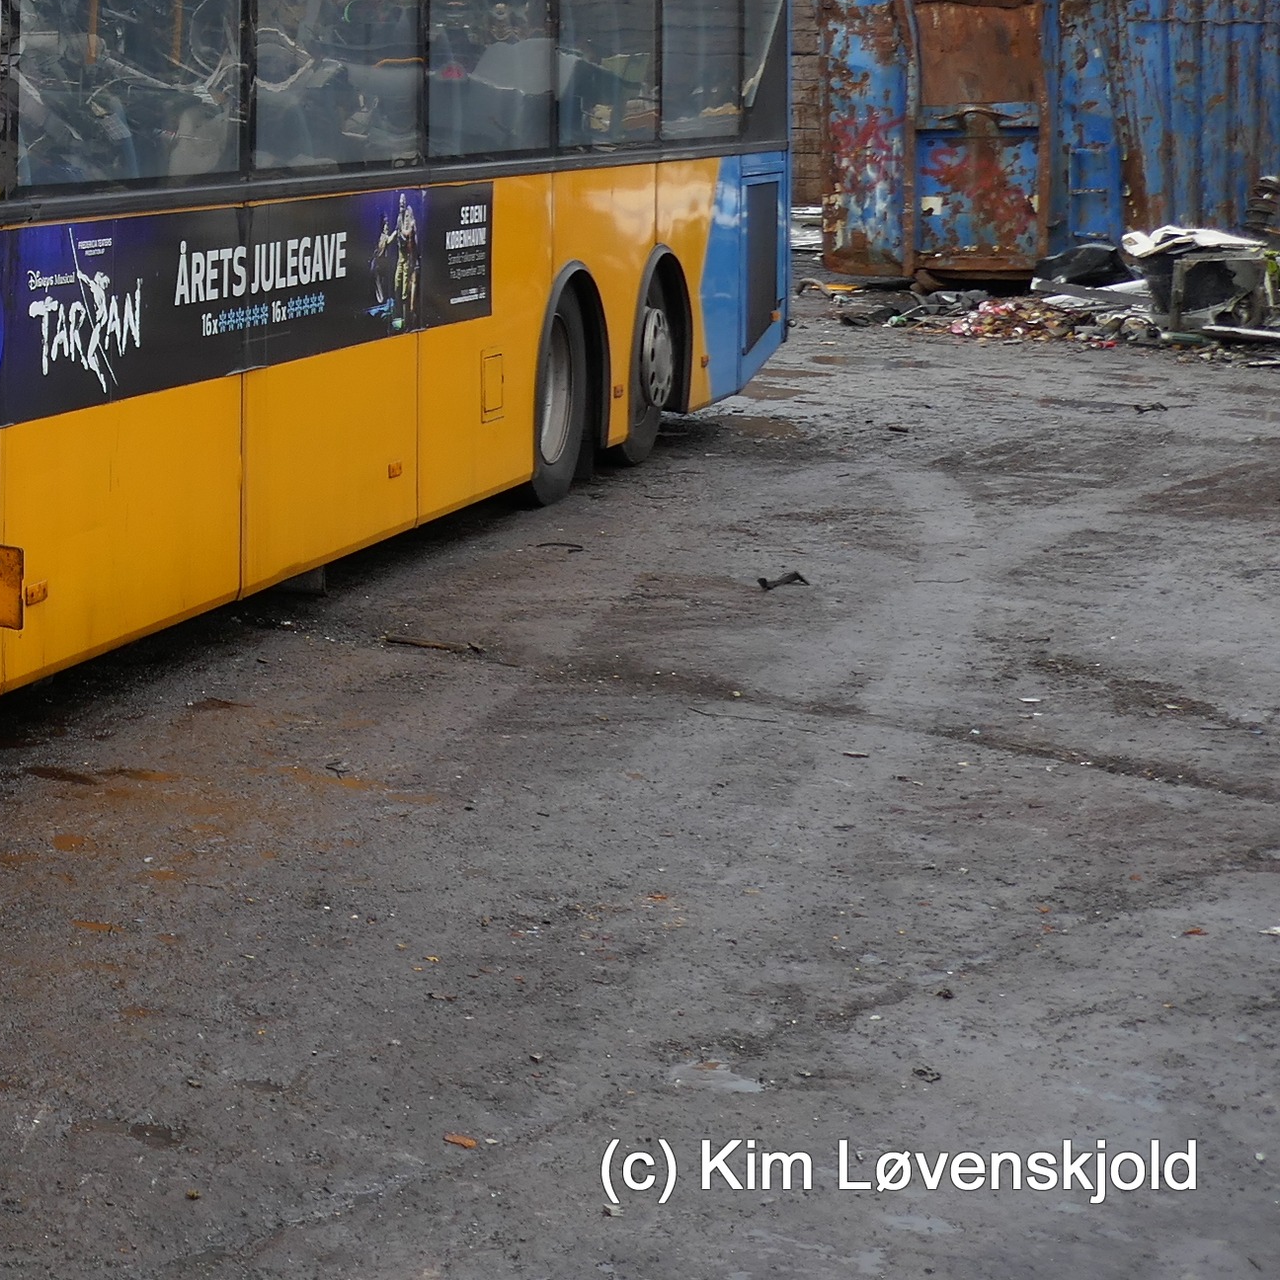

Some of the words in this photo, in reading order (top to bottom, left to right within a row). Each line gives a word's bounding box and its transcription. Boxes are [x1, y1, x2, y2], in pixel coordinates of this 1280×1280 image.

[54, 271, 75, 285] Musical
[174, 240, 247, 306] ÅRETS
[251, 231, 347, 294] JULEGAVE
[201, 313, 218, 337] 16x
[271, 300, 287, 323] 16x
